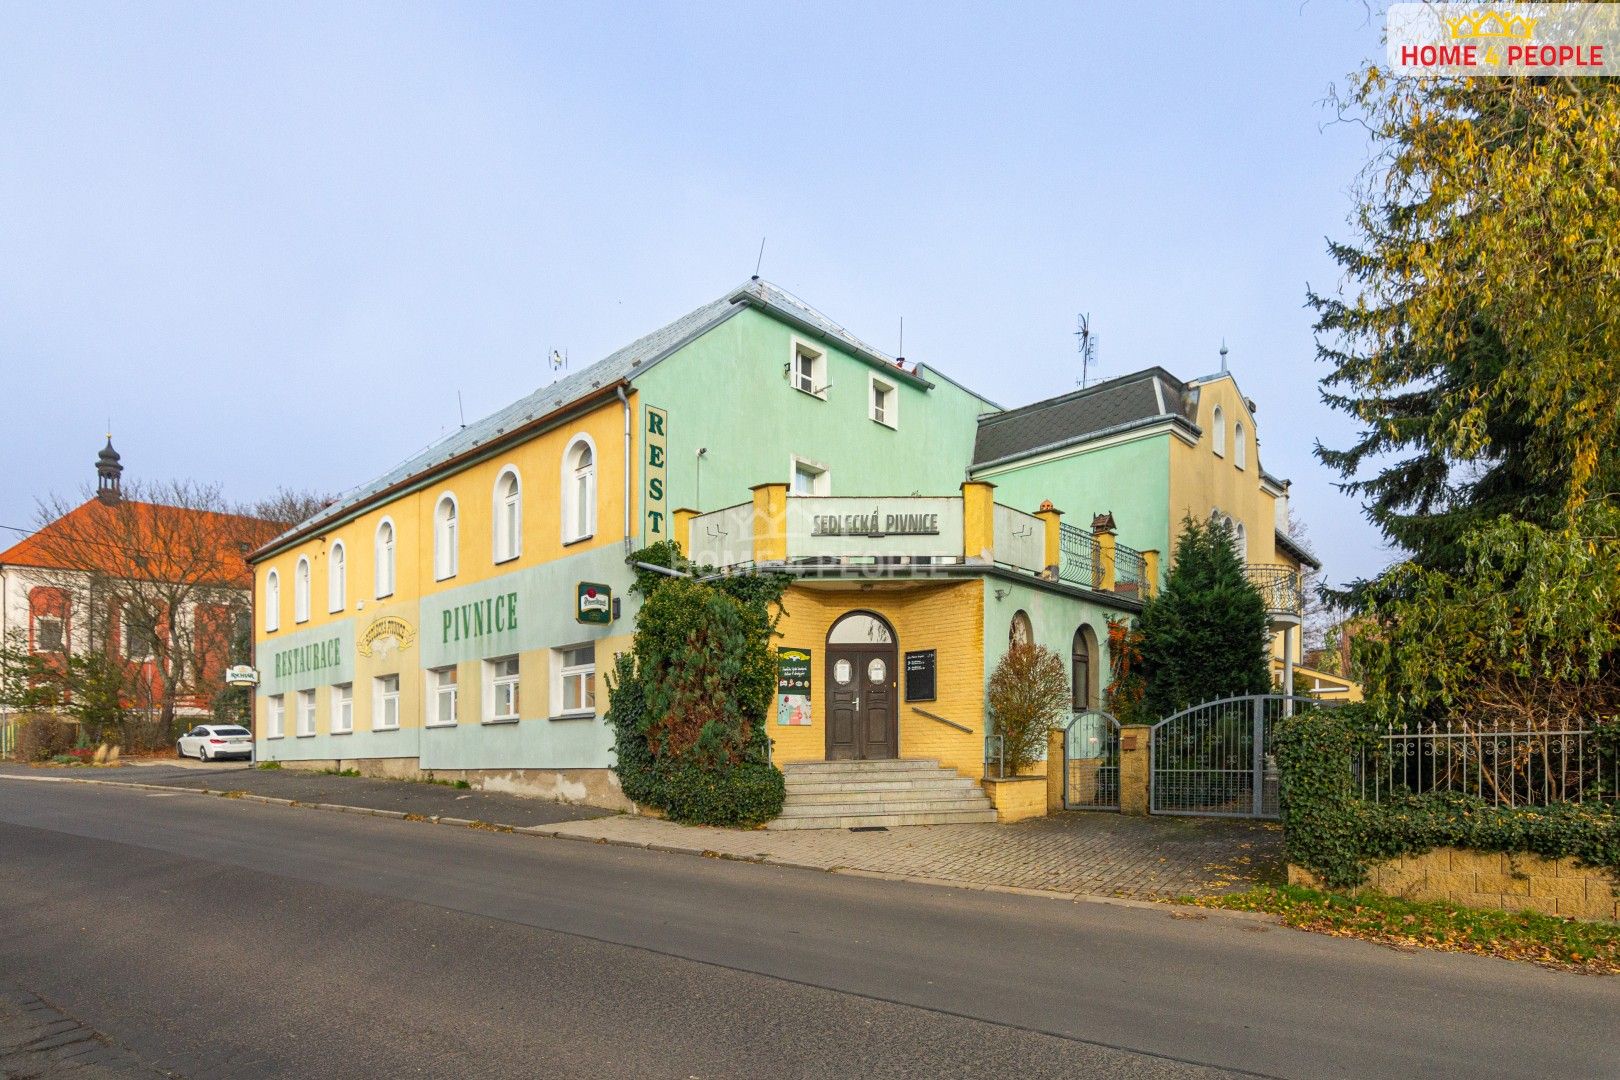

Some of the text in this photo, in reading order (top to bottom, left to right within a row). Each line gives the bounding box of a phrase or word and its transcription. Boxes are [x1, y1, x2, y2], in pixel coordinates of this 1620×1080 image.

[648, 410, 665, 534] REST
[813, 510, 939, 533] SEDLECKÁ PIVNICE
[442, 592, 518, 644] PIVNICE
[275, 637, 341, 678] RESTAURACE
